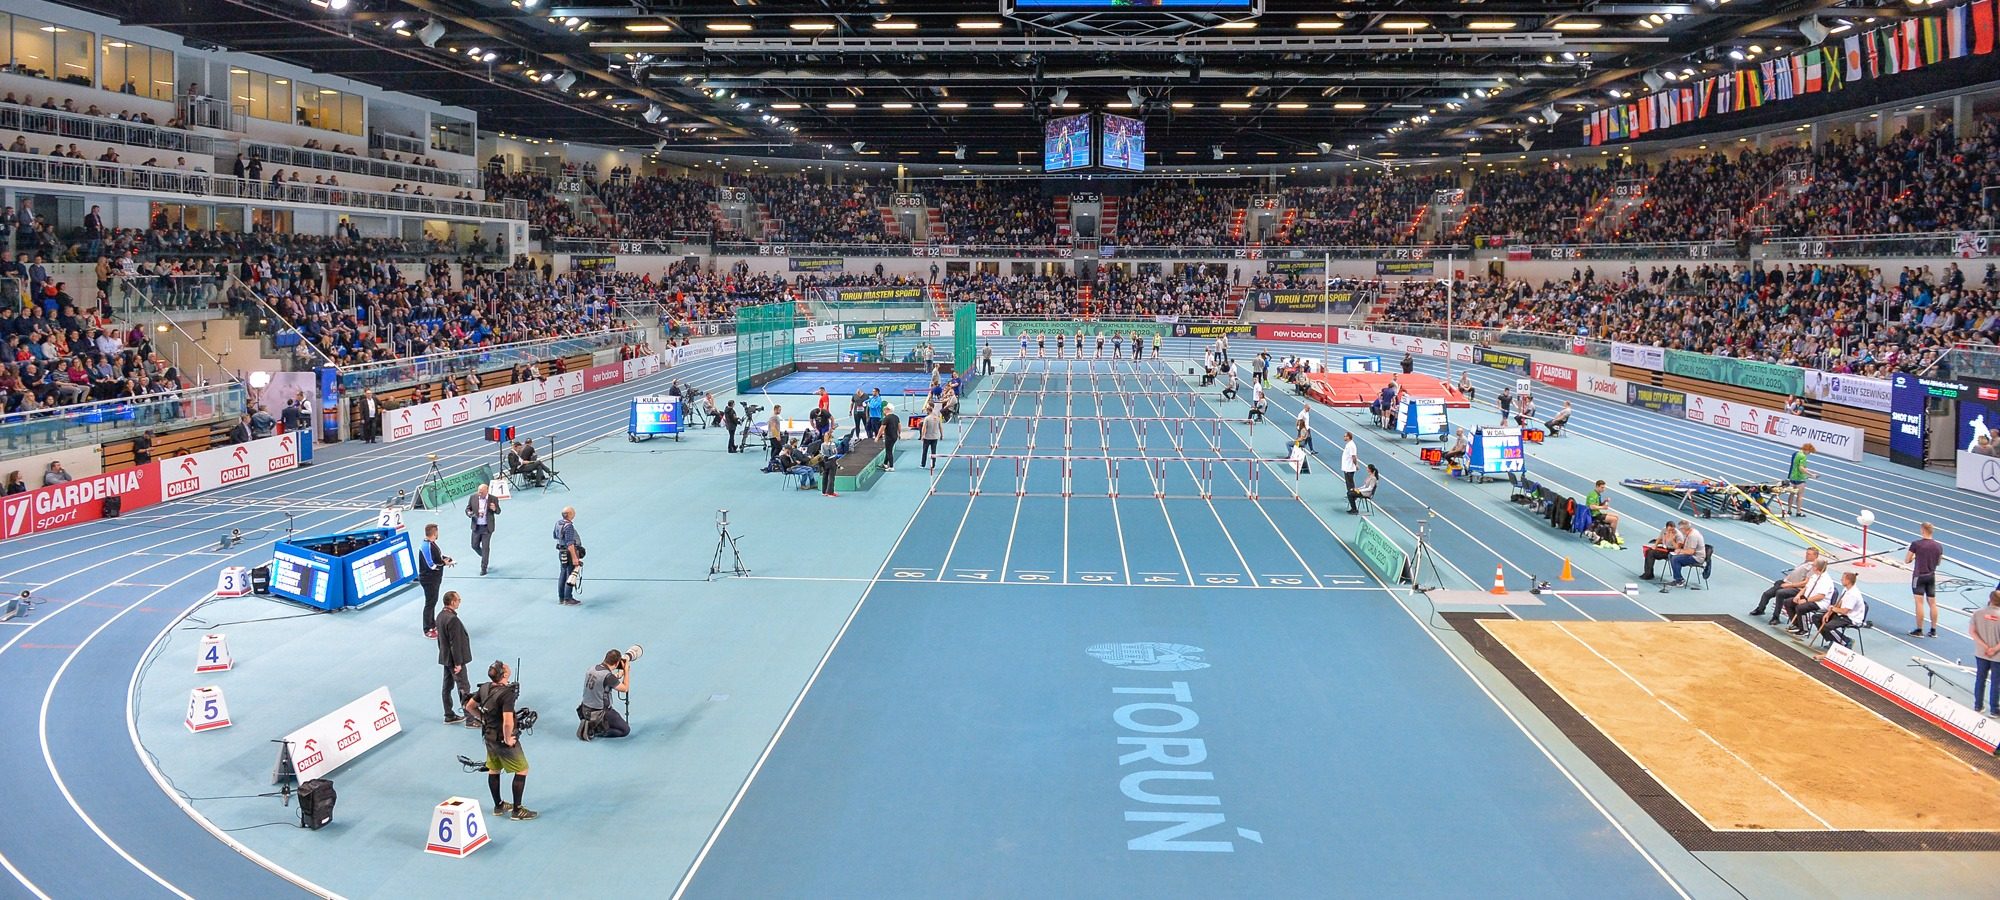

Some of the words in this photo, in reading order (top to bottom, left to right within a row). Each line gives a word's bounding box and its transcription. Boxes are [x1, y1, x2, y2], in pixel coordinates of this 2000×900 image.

[620, 244, 628, 252] A2
[632, 244, 642, 252] B2
[912, 247, 924, 256] C2
[928, 247, 940, 256] D2
[1551, 248, 1562, 258] G2
[863, 290, 894, 299] MIASTEM
[895, 288, 921, 298] SPORTU
[1302, 293, 1317, 303] CITY
[1329, 293, 1352, 302] SPORT
[1290, 330, 1323, 339] balance
[1543, 365, 1572, 380] GARDENIA
[1695, 366, 1708, 376] 2020
[1594, 380, 1617, 394] polanik
[1766, 378, 1782, 389] 2020
[1842, 385, 1860, 396] IRENY
[494, 388, 523, 412] polanik
[453, 412, 468, 424] ORLEN
[1688, 410, 1704, 420] ORLEN
[1714, 416, 1730, 426] ORLEN
[425, 418, 442, 430] ORLEN
[1742, 422, 1758, 434] ORLEN
[394, 426, 412, 438] ORLEN
[1523, 430, 1542, 442] 1:00
[1790, 424, 1807, 438] PKP
[1808, 430, 1850, 447] INTERCITY
[270, 454, 294, 470] ORLEN
[1422, 450, 1442, 462] 1:00
[222, 467, 249, 482] ORLEN
[168, 478, 199, 496] ORLEN
[463, 481, 476, 492] 2020
[498, 484, 504, 494] 1
[36, 508, 77, 530] sport
[383, 515, 390, 526] 2
[224, 576, 234, 590] 3
[241, 574, 248, 588] 3
[205, 645, 219, 664] 4
[1848, 654, 1854, 662] 5
[1888, 674, 1894, 683] 6
[1930, 694, 1938, 704] 7
[189, 699, 195, 718] 5
[204, 699, 219, 720] 5
[374, 713, 396, 730] ORLEN
[1978, 718, 1986, 729] 8
[338, 732, 360, 750] ORLEN
[298, 753, 322, 772] ORLEN
[1112, 681, 1264, 853] TORUŃ
[439, 817, 452, 842] 6
[466, 812, 478, 838] 6
